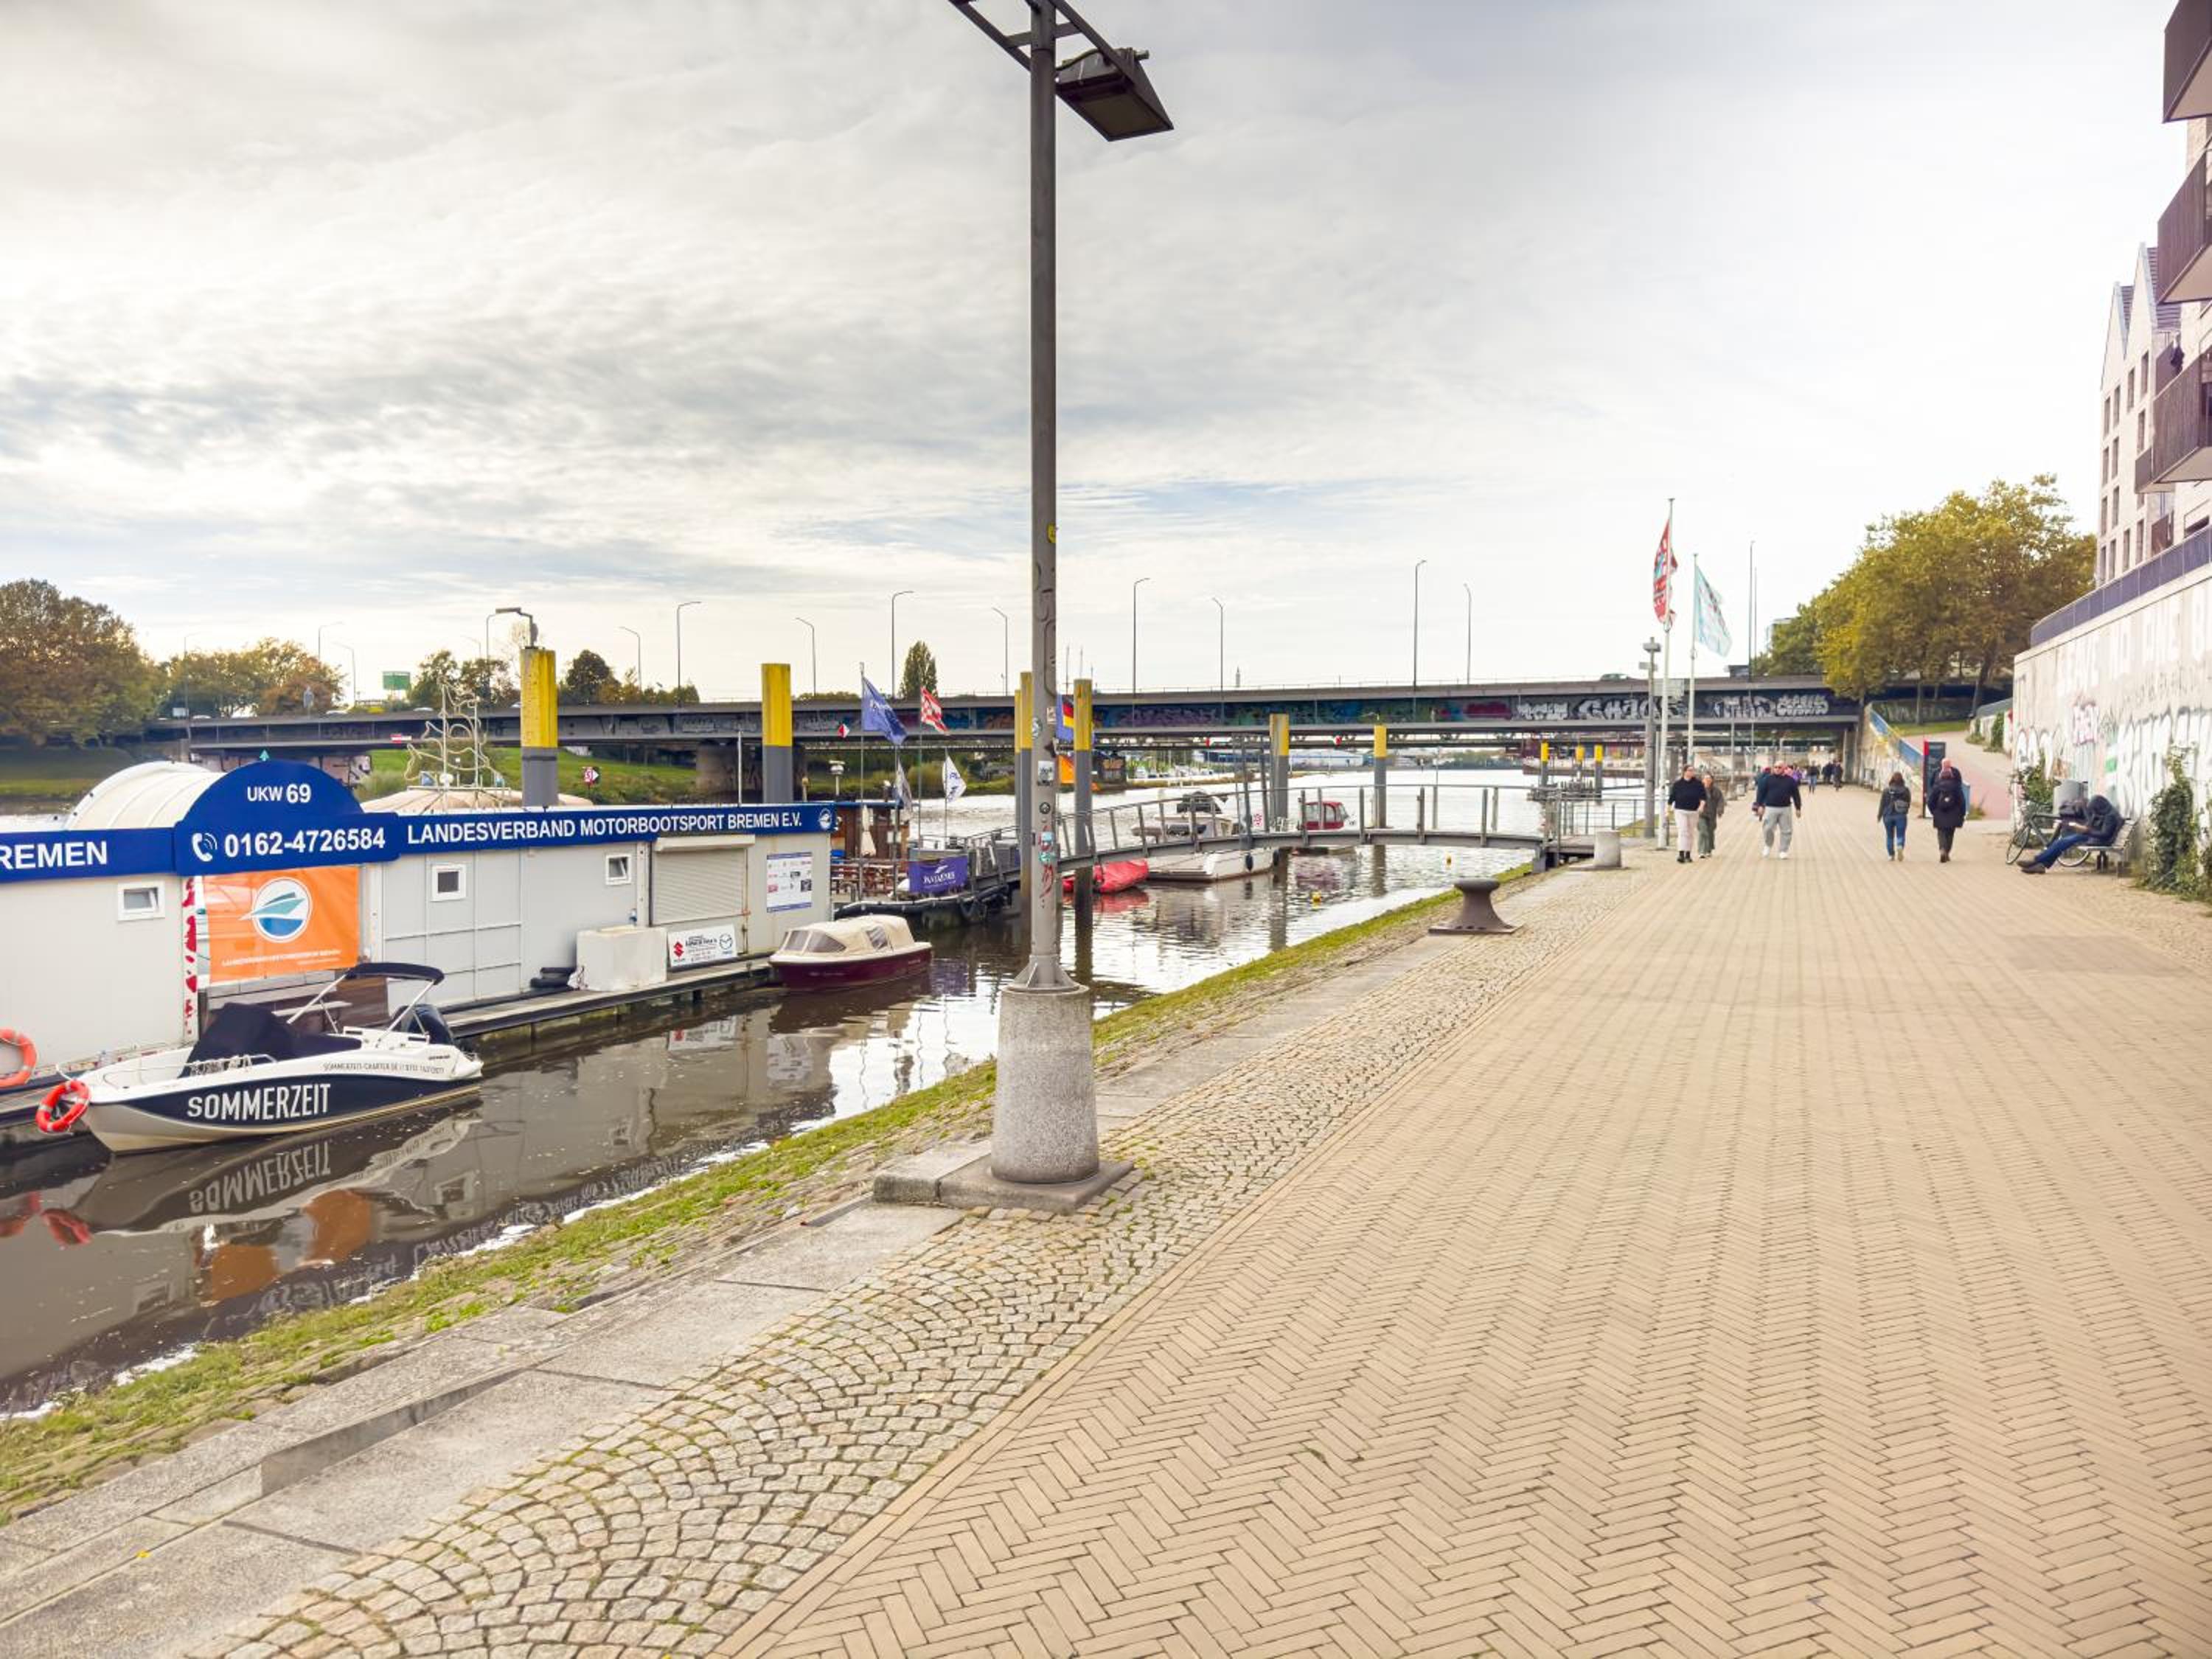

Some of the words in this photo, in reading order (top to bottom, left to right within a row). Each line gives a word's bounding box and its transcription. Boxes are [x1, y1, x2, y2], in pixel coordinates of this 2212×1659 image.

[247, 786, 283, 801] UKW
[286, 784, 312, 804] 69
[224, 827, 386, 858] 0162-4726584
[408, 819, 575, 844] LANDESVERBAND
[580, 814, 724, 837] MOTORBOOTSPORT
[728, 813, 779, 830] BREMEN
[782, 812, 802, 827] E.V.
[187, 1083, 331, 1121] SOMMERZEIT
